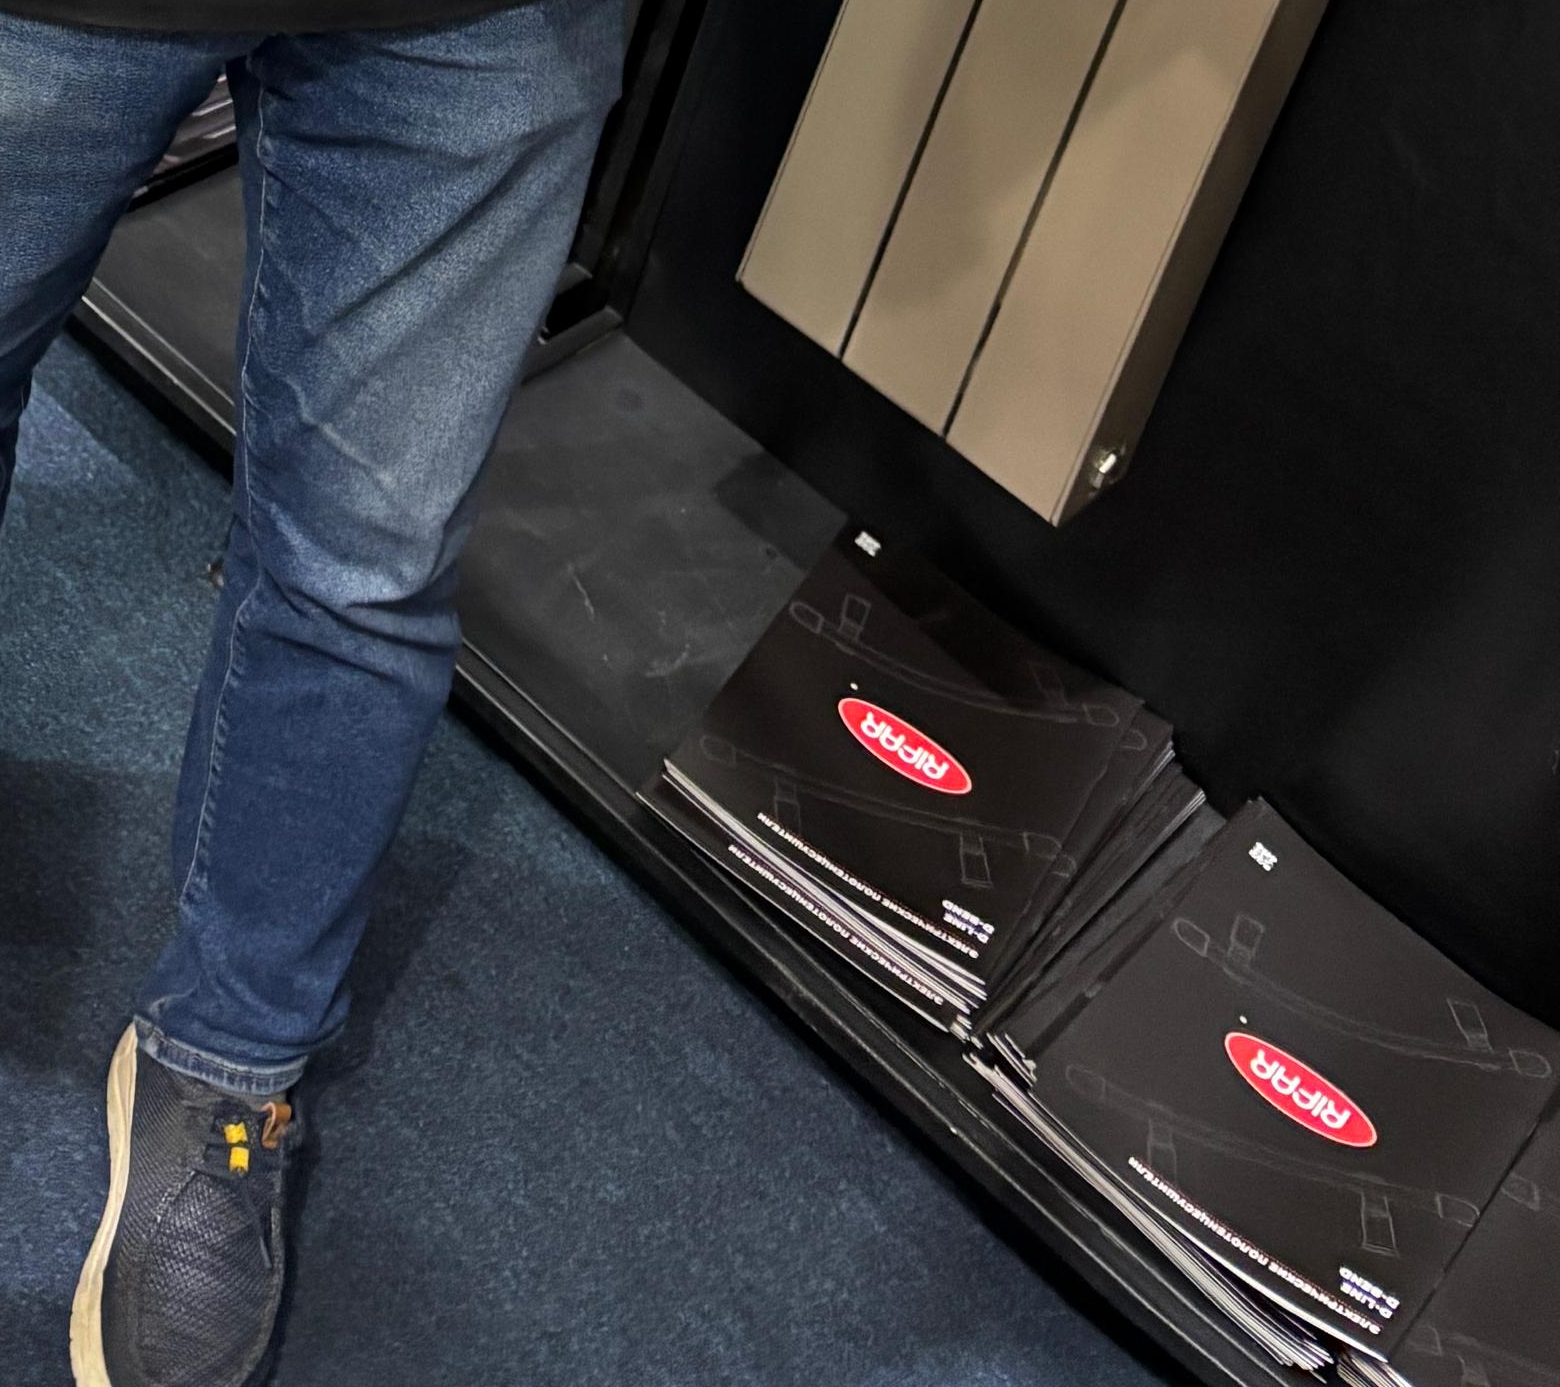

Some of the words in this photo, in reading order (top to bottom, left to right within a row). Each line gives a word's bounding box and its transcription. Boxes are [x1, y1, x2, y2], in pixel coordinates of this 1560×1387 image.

[860, 711, 950, 780] RIFAR
[727, 843, 851, 940] ПОЛОТЕНЦЕСУШИТЕЛИ
[756, 811, 883, 903] ПОЛОТЕНЦЕСУШИТЕЛИ
[881, 895, 980, 960] ЭЛЕКТРИЧЕСКИЕ
[942, 912, 990, 944] D-LINE
[848, 935, 945, 1006] ЭЛЕКТРИЧЕСКИЕ
[1249, 1048, 1352, 1129] RIFAR
[1127, 1156, 1270, 1267] ПОЛОТЕНЦЕСУШИТЕЛИ
[1267, 1260, 1382, 1336] ЭЛЕКТРИЧЕСКИЕ
[1340, 1281, 1394, 1320] D-LINE
